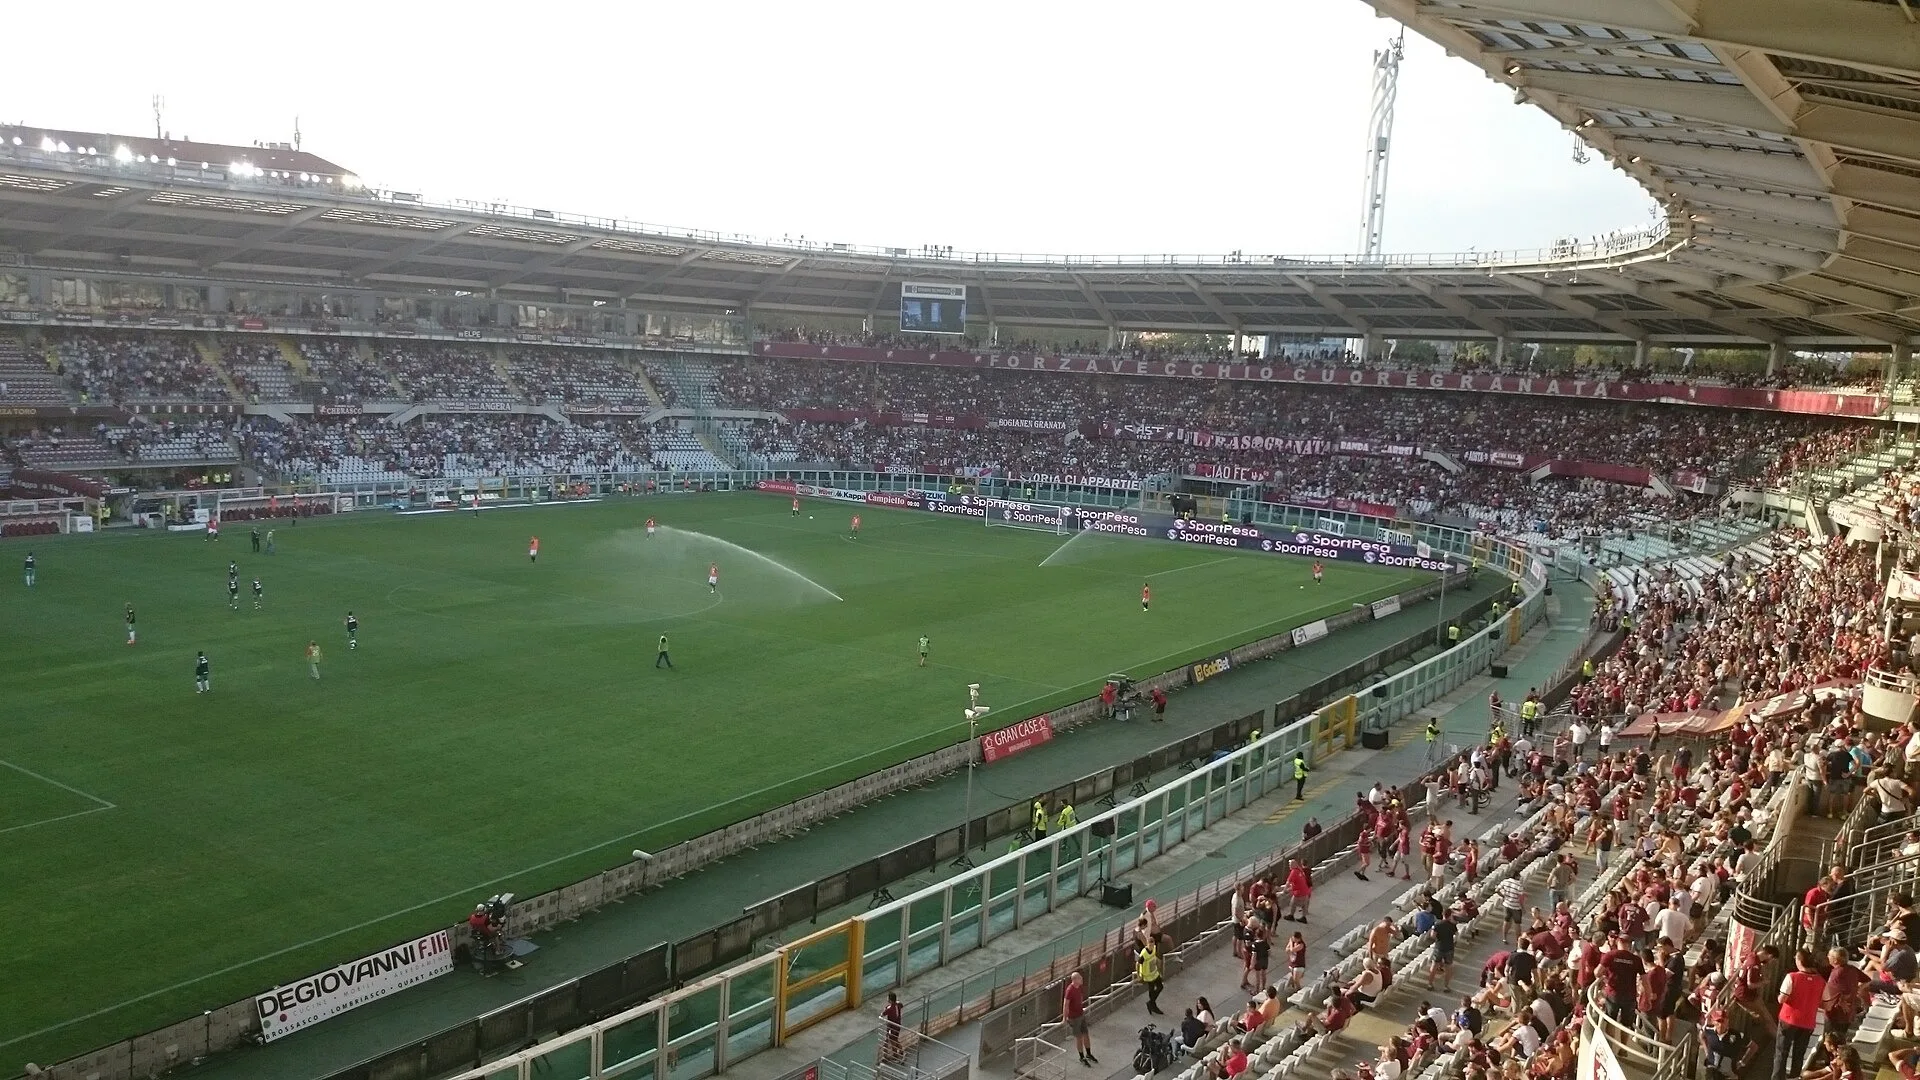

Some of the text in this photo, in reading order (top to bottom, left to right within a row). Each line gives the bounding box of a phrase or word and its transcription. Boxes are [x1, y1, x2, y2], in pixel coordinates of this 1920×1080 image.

[1033, 421, 1067, 430] GRANATA
[843, 492, 866, 501] Kappa
[937, 502, 984, 517] SportPesa
[1074, 507, 1138, 524] SportPesa
[1094, 520, 1147, 537] SportPesa
[1188, 519, 1259, 538] SportPesa
[1179, 529, 1238, 547] SportPesa
[1312, 533, 1391, 554] SportPesa
[1274, 540, 1338, 559] SportPesa
[994, 726, 1019, 746] GRAN
[1018, 719, 1039, 737] CASE
[257, 944, 416, 1019] DEGIOVANNI
